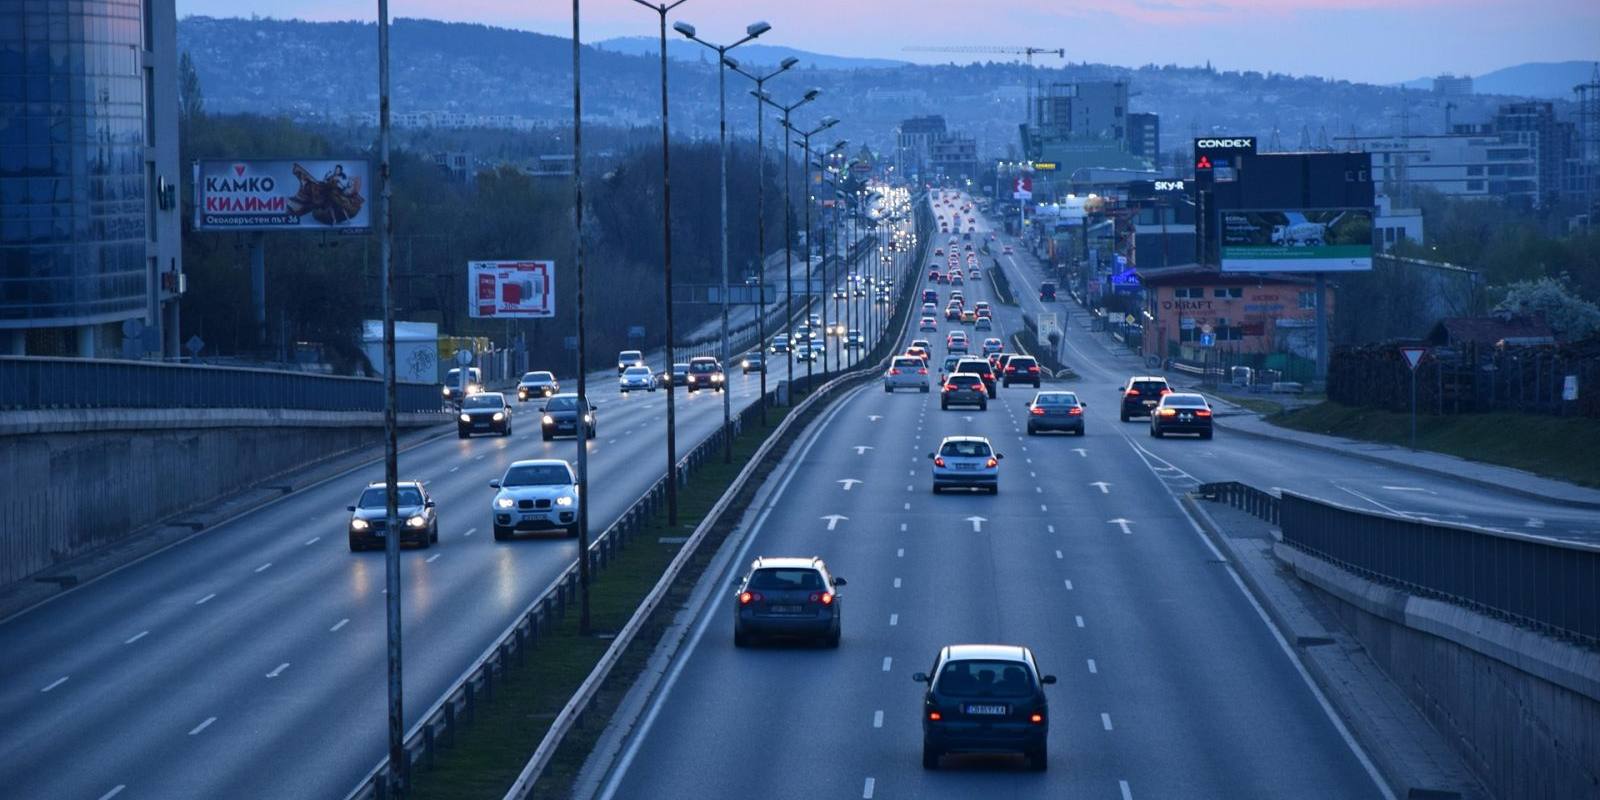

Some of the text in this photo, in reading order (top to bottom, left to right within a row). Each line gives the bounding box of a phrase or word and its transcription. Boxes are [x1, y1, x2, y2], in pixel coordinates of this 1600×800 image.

[1198, 139, 1251, 148] CONDEX
[207, 177, 274, 192] КАМКО
[207, 197, 285, 211] КИЛИМИ
[1174, 301, 1213, 309] KRAFT
